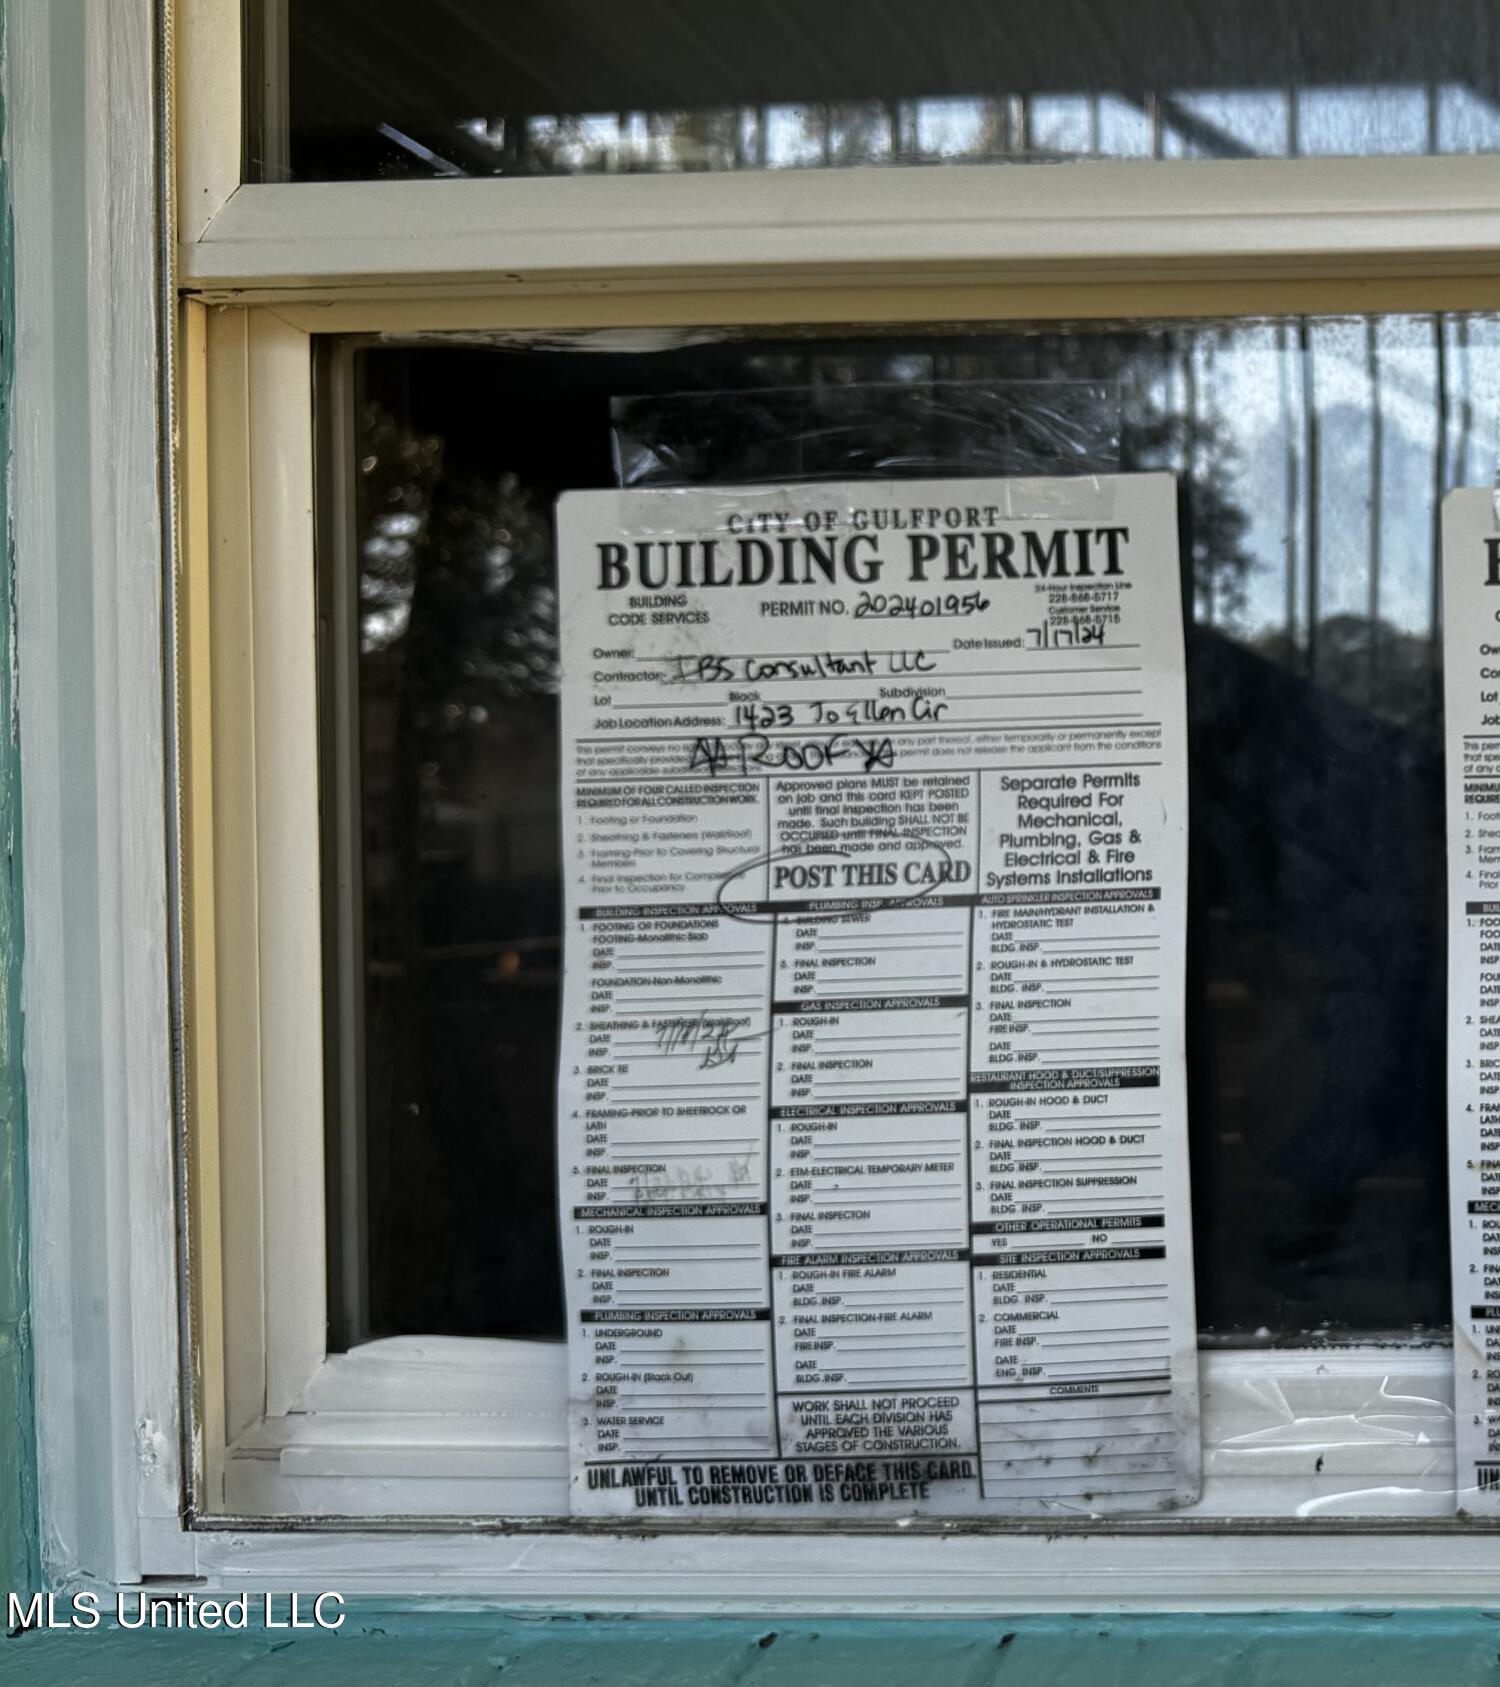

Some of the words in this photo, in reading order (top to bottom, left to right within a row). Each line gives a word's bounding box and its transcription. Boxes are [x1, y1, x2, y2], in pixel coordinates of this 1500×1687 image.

[727, 511, 790, 535] CITY
[803, 510, 838, 531] OF
[852, 505, 999, 531] GULFPORT
[596, 533, 885, 590] BUILDING
[907, 527, 1130, 582] PERMIT
[629, 594, 688, 608] BUILDING
[760, 601, 815, 618] PERMIT
[820, 600, 849, 616] NO.
[608, 612, 647, 626] CODE
[651, 610, 710, 625] SERVICES
[953, 638, 983, 650] Date
[983, 637, 1025, 649] Issued:
[889, 650, 937, 673] LLC
[728, 690, 762, 702] Block
[879, 686, 946, 698] Subdivision
[1481, 690, 1499, 703] Lot
[593, 718, 615, 730] Job
[618, 717, 672, 728] Location
[673, 716, 726, 727] Address:
[736, 704, 794, 731] 1423
[1001, 775, 1077, 793] Separate
[1083, 772, 1141, 788] Permits
[1018, 794, 1092, 812] Required
[1099, 792, 1124, 807] For
[1018, 812, 1123, 829] Mechanical,
[1000, 833, 1081, 851] Plumbing,
[1088, 831, 1122, 845] Gas
[1129, 829, 1142, 844] &
[1004, 851, 1081, 868] Electrical
[1088, 850, 1100, 864] &
[1107, 850, 1135, 864] Fire
[775, 864, 837, 889] POST
[842, 862, 898, 886] THIS
[904, 860, 971, 884] CARD
[987, 871, 1051, 890] Systems
[1056, 868, 1153, 884] Installations
[581, 1208, 644, 1217] MECHANICAL
[648, 1206, 702, 1216] INSPECTION
[706, 1204, 760, 1214] APPROVALS
[588, 1225, 634, 1234] ROUGH-IN
[588, 1466, 678, 1489] UNLAWFUL
[682, 1466, 704, 1485] TO
[710, 1464, 778, 1485] REMOVE
[785, 1463, 807, 1483] OR
[813, 1462, 877, 1482] DEFACE
[882, 1461, 921, 1481] THIS
[927, 1460, 976, 1480] CARD
[635, 1487, 684, 1507] UNTIL
[688, 1483, 812, 1506] CONSTRUCTION
[820, 1483, 835, 1501] IS
[840, 1482, 930, 1501] COMPLETE
